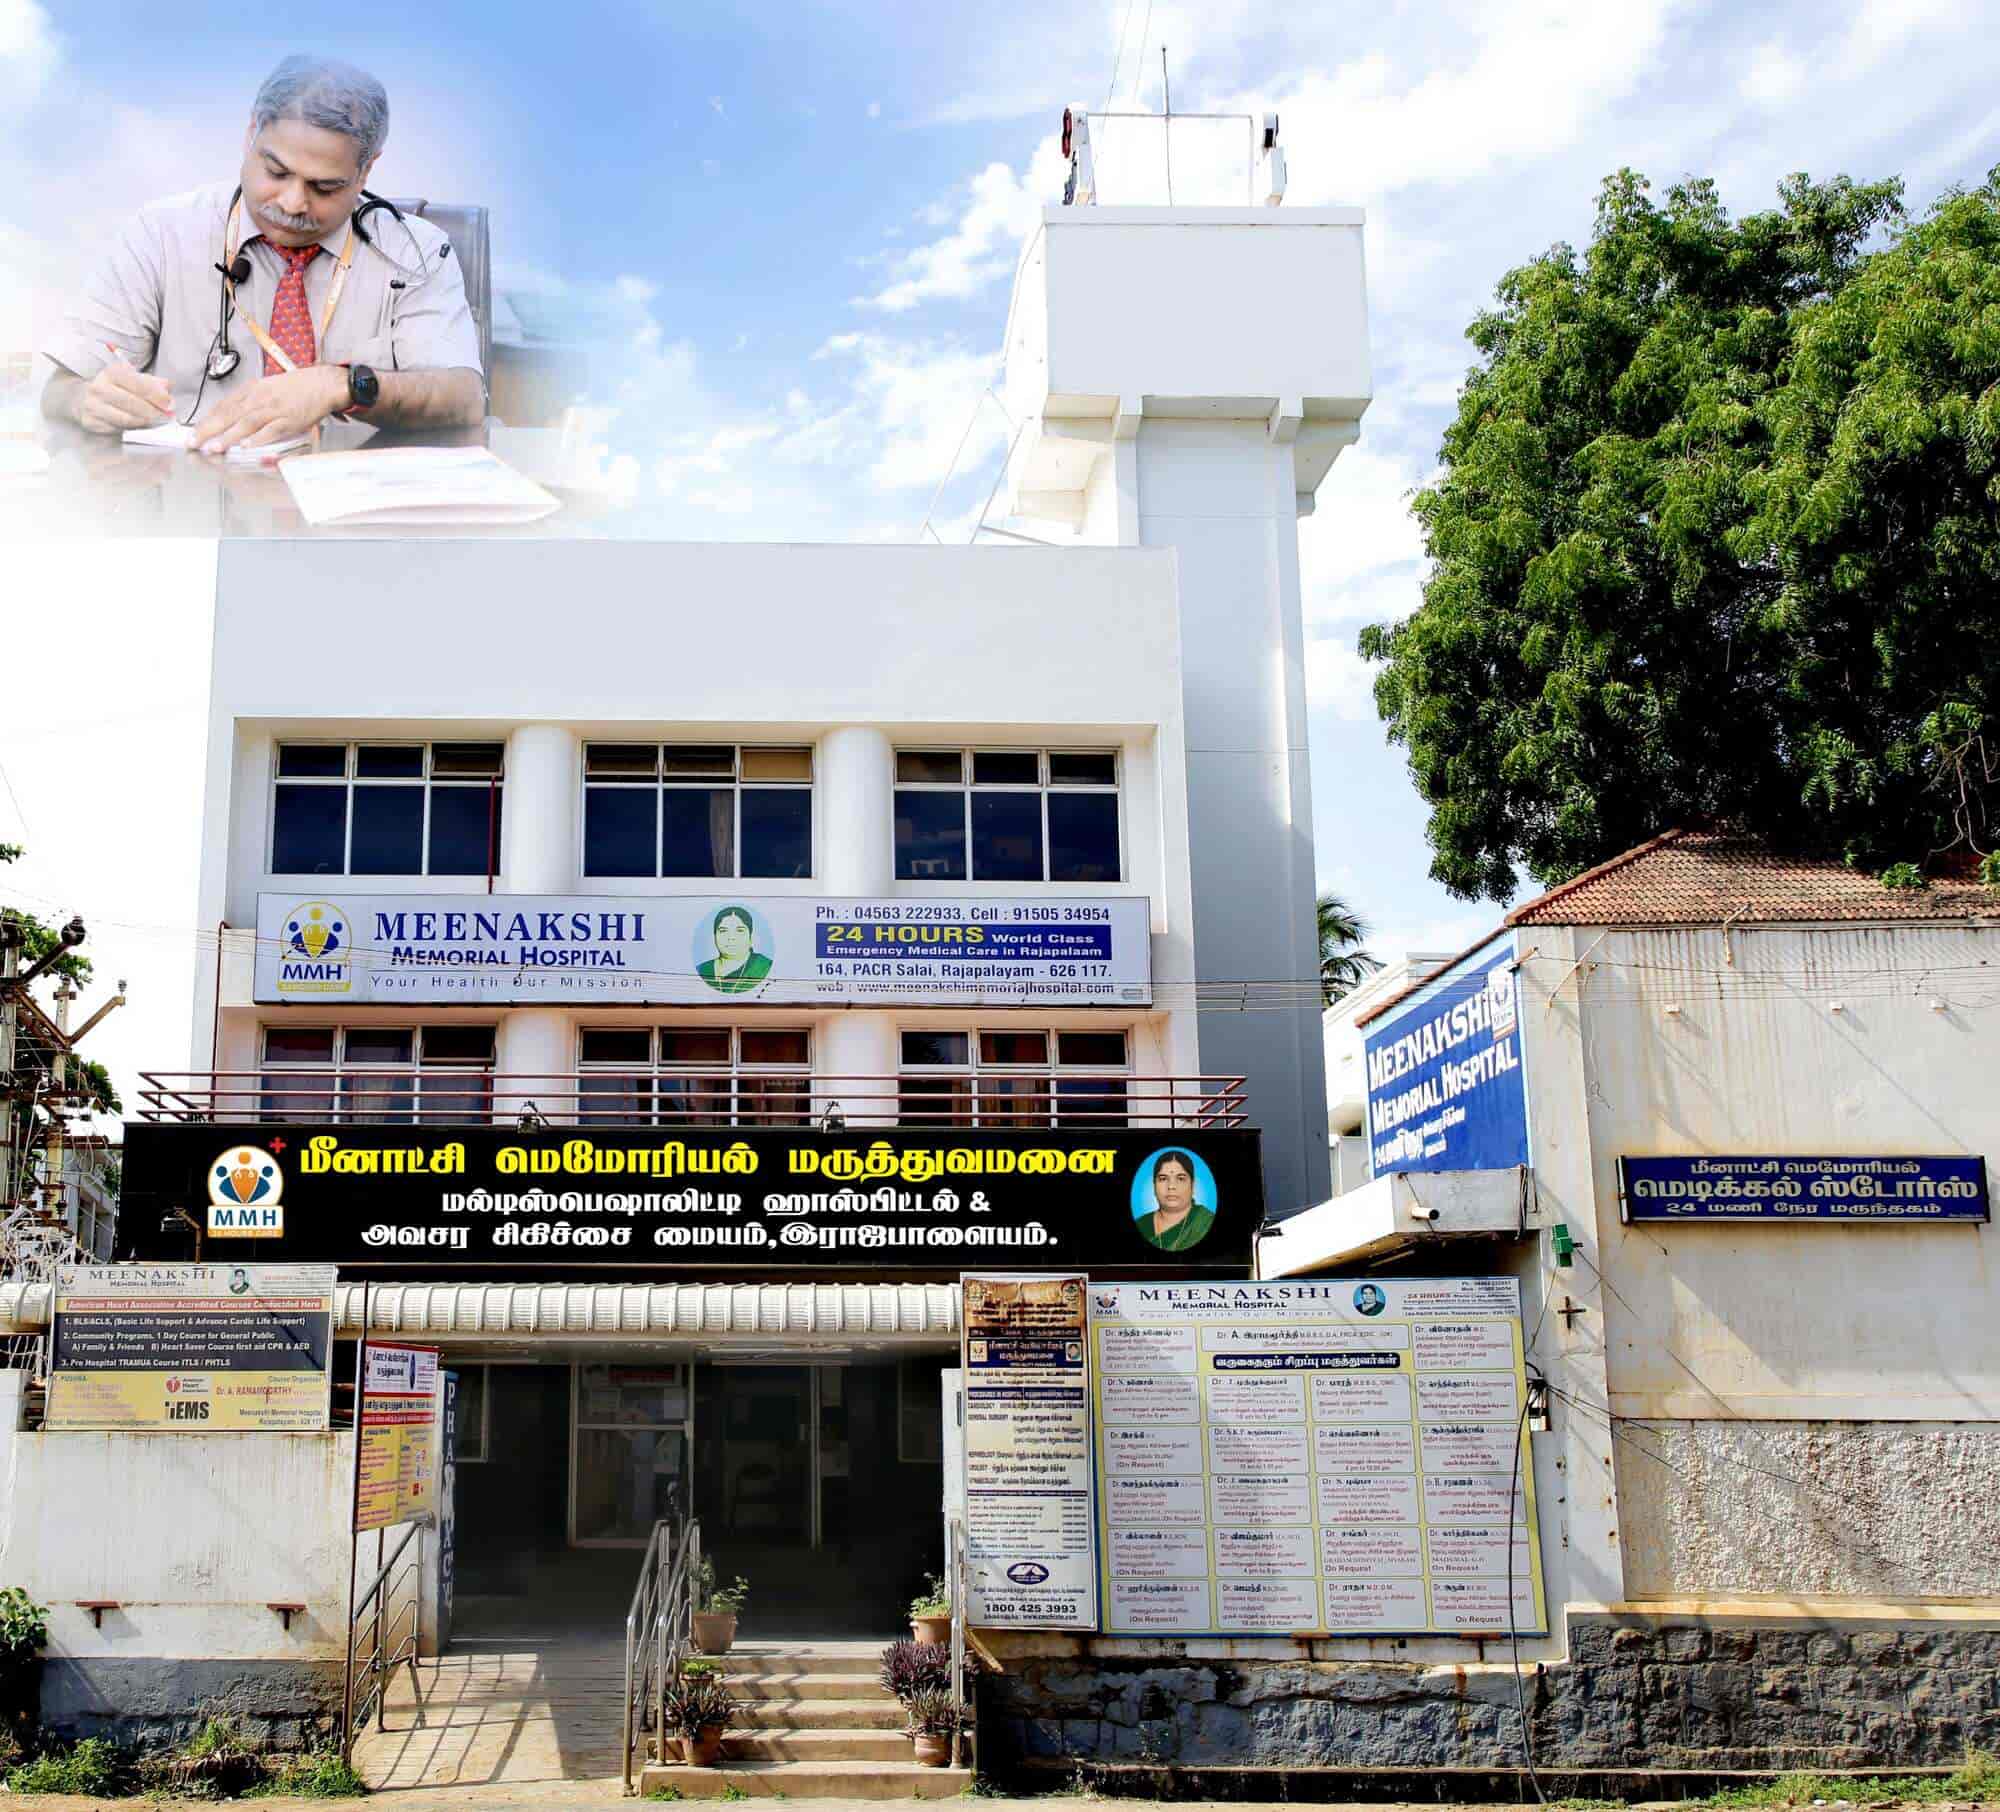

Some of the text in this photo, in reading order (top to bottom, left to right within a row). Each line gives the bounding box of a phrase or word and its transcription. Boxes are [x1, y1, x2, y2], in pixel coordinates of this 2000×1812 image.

[816, 905, 839, 919] Ph.
[854, 906, 900, 920] 04563
[971, 907, 998, 921] Cell
[1013, 908, 1059, 920] 91505
[1064, 908, 1110, 920] 34954
[374, 912, 645, 942] MEENAKSHI
[826, 925, 1094, 944] 24 HOURS World Class
[391, 946, 625, 966] MEMORIAL HOSPITAL
[826, 945, 1102, 958] Emergency Medical Care in Rajapalaam
[282, 964, 342, 980] MMH
[853, 963, 892, 977] PACR
[942, 965, 1035, 979] Rajapalayam
[1050, 965, 1076, 977] 626
[371, 975, 642, 988] Your Health Our Mission
[816, 981, 844, 992] web
[1368, 986, 1491, 1091] MEENAKSHI
[1371, 1039, 1519, 1136] MEMORIAL HOSPITAL
[300, 1135, 1117, 1182] மீனாட்சி மெமோரியல் மருத்துவமனை
[1691, 1159, 1920, 1174] மீனாட்சி மெமோரியல்
[1634, 1175, 1978, 1202] மெடிக்கல் ஸ்டோர்ஸ்
[442, 1188, 991, 1216] மல்டிஸ்பெஷாலிட்டி ஹாஸ்பிட்டல் &
[1666, 1202, 1941, 1215] 24 மணி நேர மருந்தகம்
[214, 1209, 276, 1226] MMH
[361, 1222, 470, 1249] அவசர
[491, 1220, 633, 1249] சிகிச்சை
[89, 1270, 215, 1280] MEENAKSHI
[1139, 1287, 1331, 1300] MEENAKSHI
[107, 1301, 129, 1309] Heart
[301, 1300, 320, 1309] Here
[1172, 1300, 1287, 1309] MEMORIAL HOSPITAL
[114, 1318, 138, 1327] (Basic
[156, 1318, 186, 1328] Support
[272, 1317, 305, 1327] Support)
[72, 1332, 114, 1341] Community
[163, 1332, 178, 1341] Day
[207, 1331, 219, 1339] for
[221, 1331, 250, 1339] General
[252, 1331, 275, 1339] Public
[82, 1343, 108, 1352] Family
[254, 1342, 265, 1350] aid
[267, 1342, 283, 1350] CPR
[293, 1342, 310, 1350] AED
[85, 1359, 116, 1368] Hospital
[1285, 1354, 1319, 1368] சிறப்பு
[1321, 1353, 1398, 1368] மருத்துவர்கள்
[1339, 1565, 1371, 1573] Request
[1432, 1564, 1479, 1572] On Request
[985, 1604, 1076, 1613] 1800 425 3993
[1455, 1615, 1503, 1624] On Request
